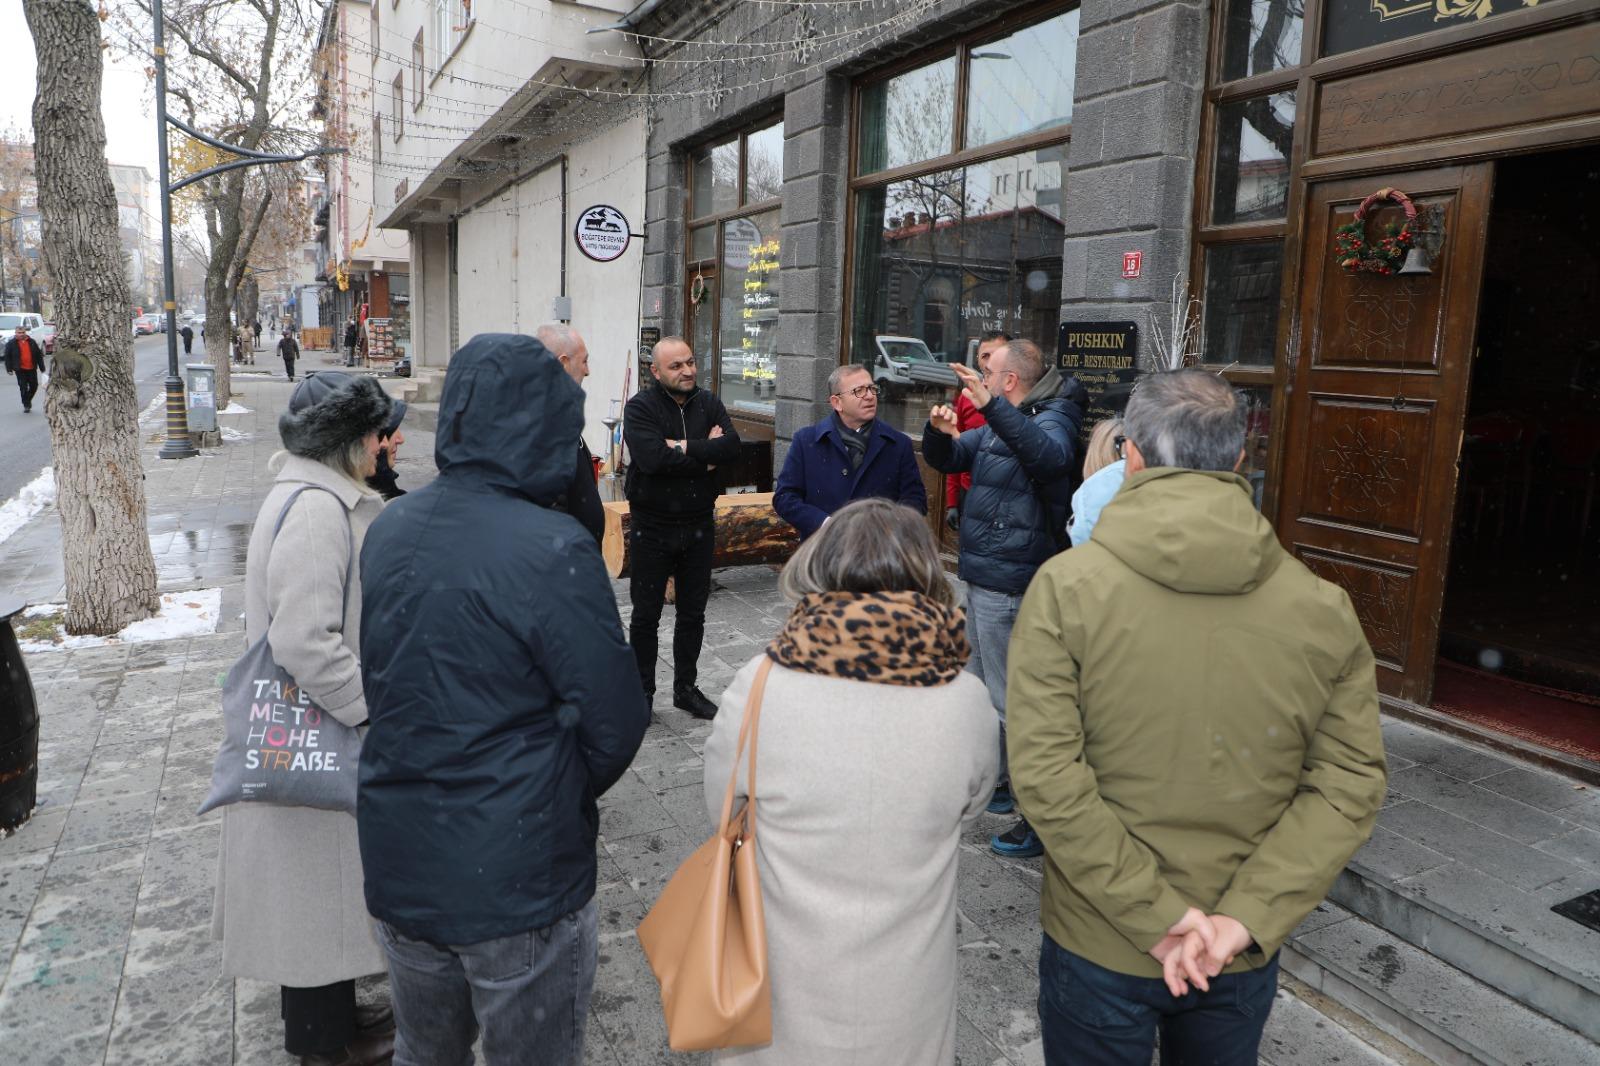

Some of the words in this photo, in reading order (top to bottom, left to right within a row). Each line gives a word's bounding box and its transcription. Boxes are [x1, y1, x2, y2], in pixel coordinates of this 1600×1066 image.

[1068, 333, 1126, 349] PUSHKIN
[1062, 354, 1079, 368] CAFE
[1084, 355, 1133, 369] RESTAURANT
[254, 681, 310, 704] TAKE
[250, 703, 286, 724] ME
[291, 707, 321, 726] TO
[247, 726, 320, 748] HOHE
